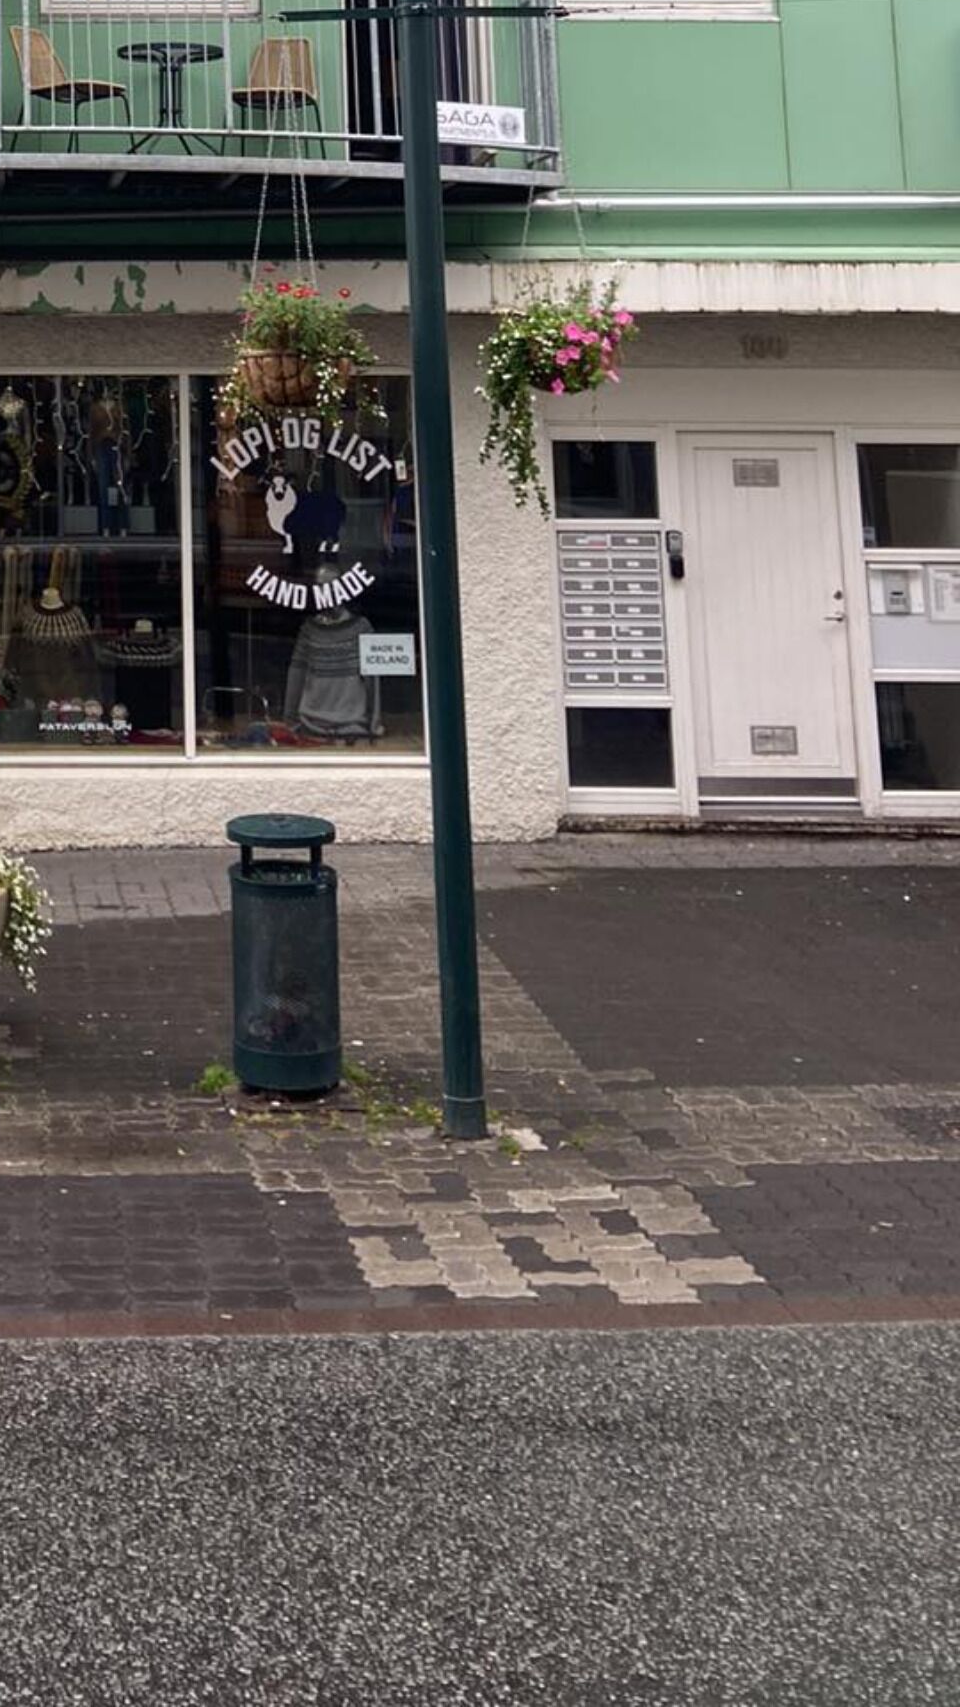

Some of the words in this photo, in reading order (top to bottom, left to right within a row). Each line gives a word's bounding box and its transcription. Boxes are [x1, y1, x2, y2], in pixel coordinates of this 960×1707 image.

[437, 109, 496, 127] SAGA
[210, 422, 276, 481] LOPI
[282, 417, 321, 449] OG
[326, 427, 392, 482] LIST
[246, 564, 307, 610] HAND
[312, 561, 376, 610] MADE
[366, 655, 410, 664] ICELAND
